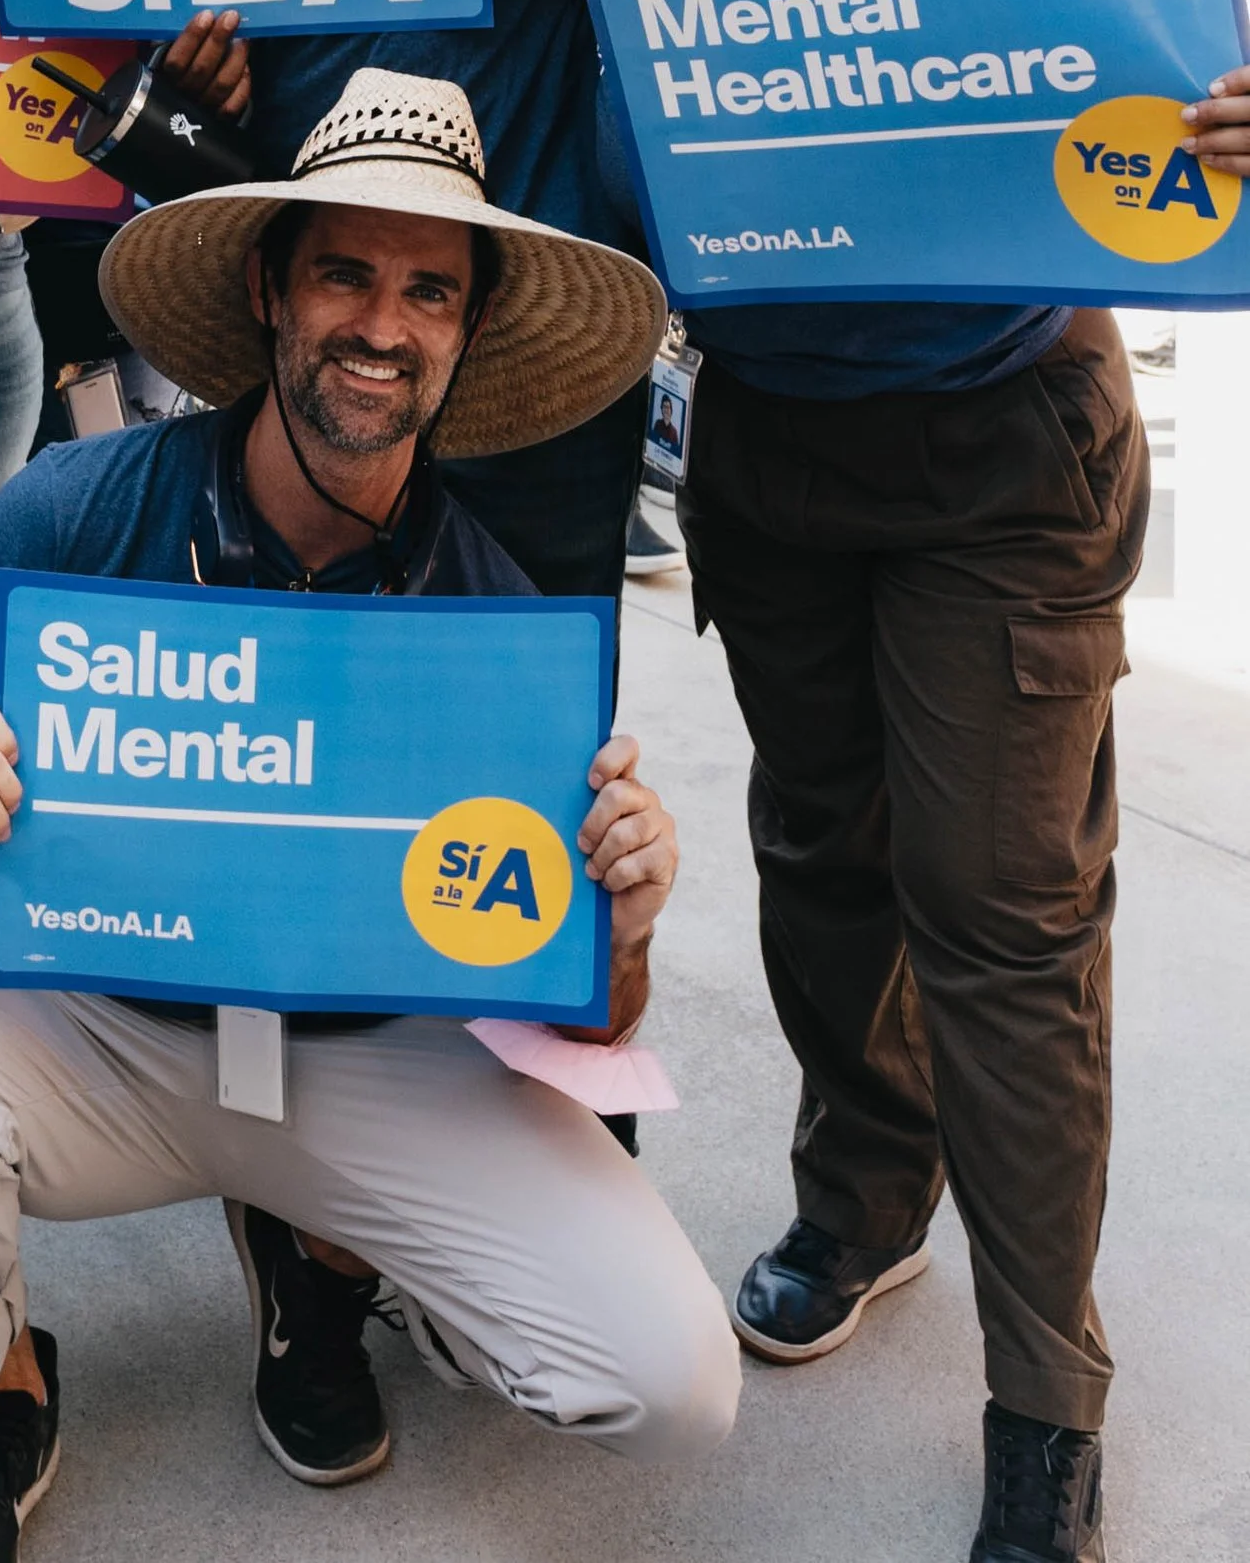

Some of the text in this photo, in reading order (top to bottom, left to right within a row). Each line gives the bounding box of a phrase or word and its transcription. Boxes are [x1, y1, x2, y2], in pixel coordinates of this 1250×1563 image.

[6, 83, 57, 119] Yes
[653, 45, 1097, 119] Healthcare
[25, 121, 44, 134] on
[1072, 142, 1219, 220] Yes on A
[687, 225, 855, 255] YesOnA.LA
[36, 621, 258, 704] Salud
[35, 701, 314, 785] Mental
[433, 841, 541, 922] Sí a la A
[25, 902, 195, 941] YesOnA.LA
